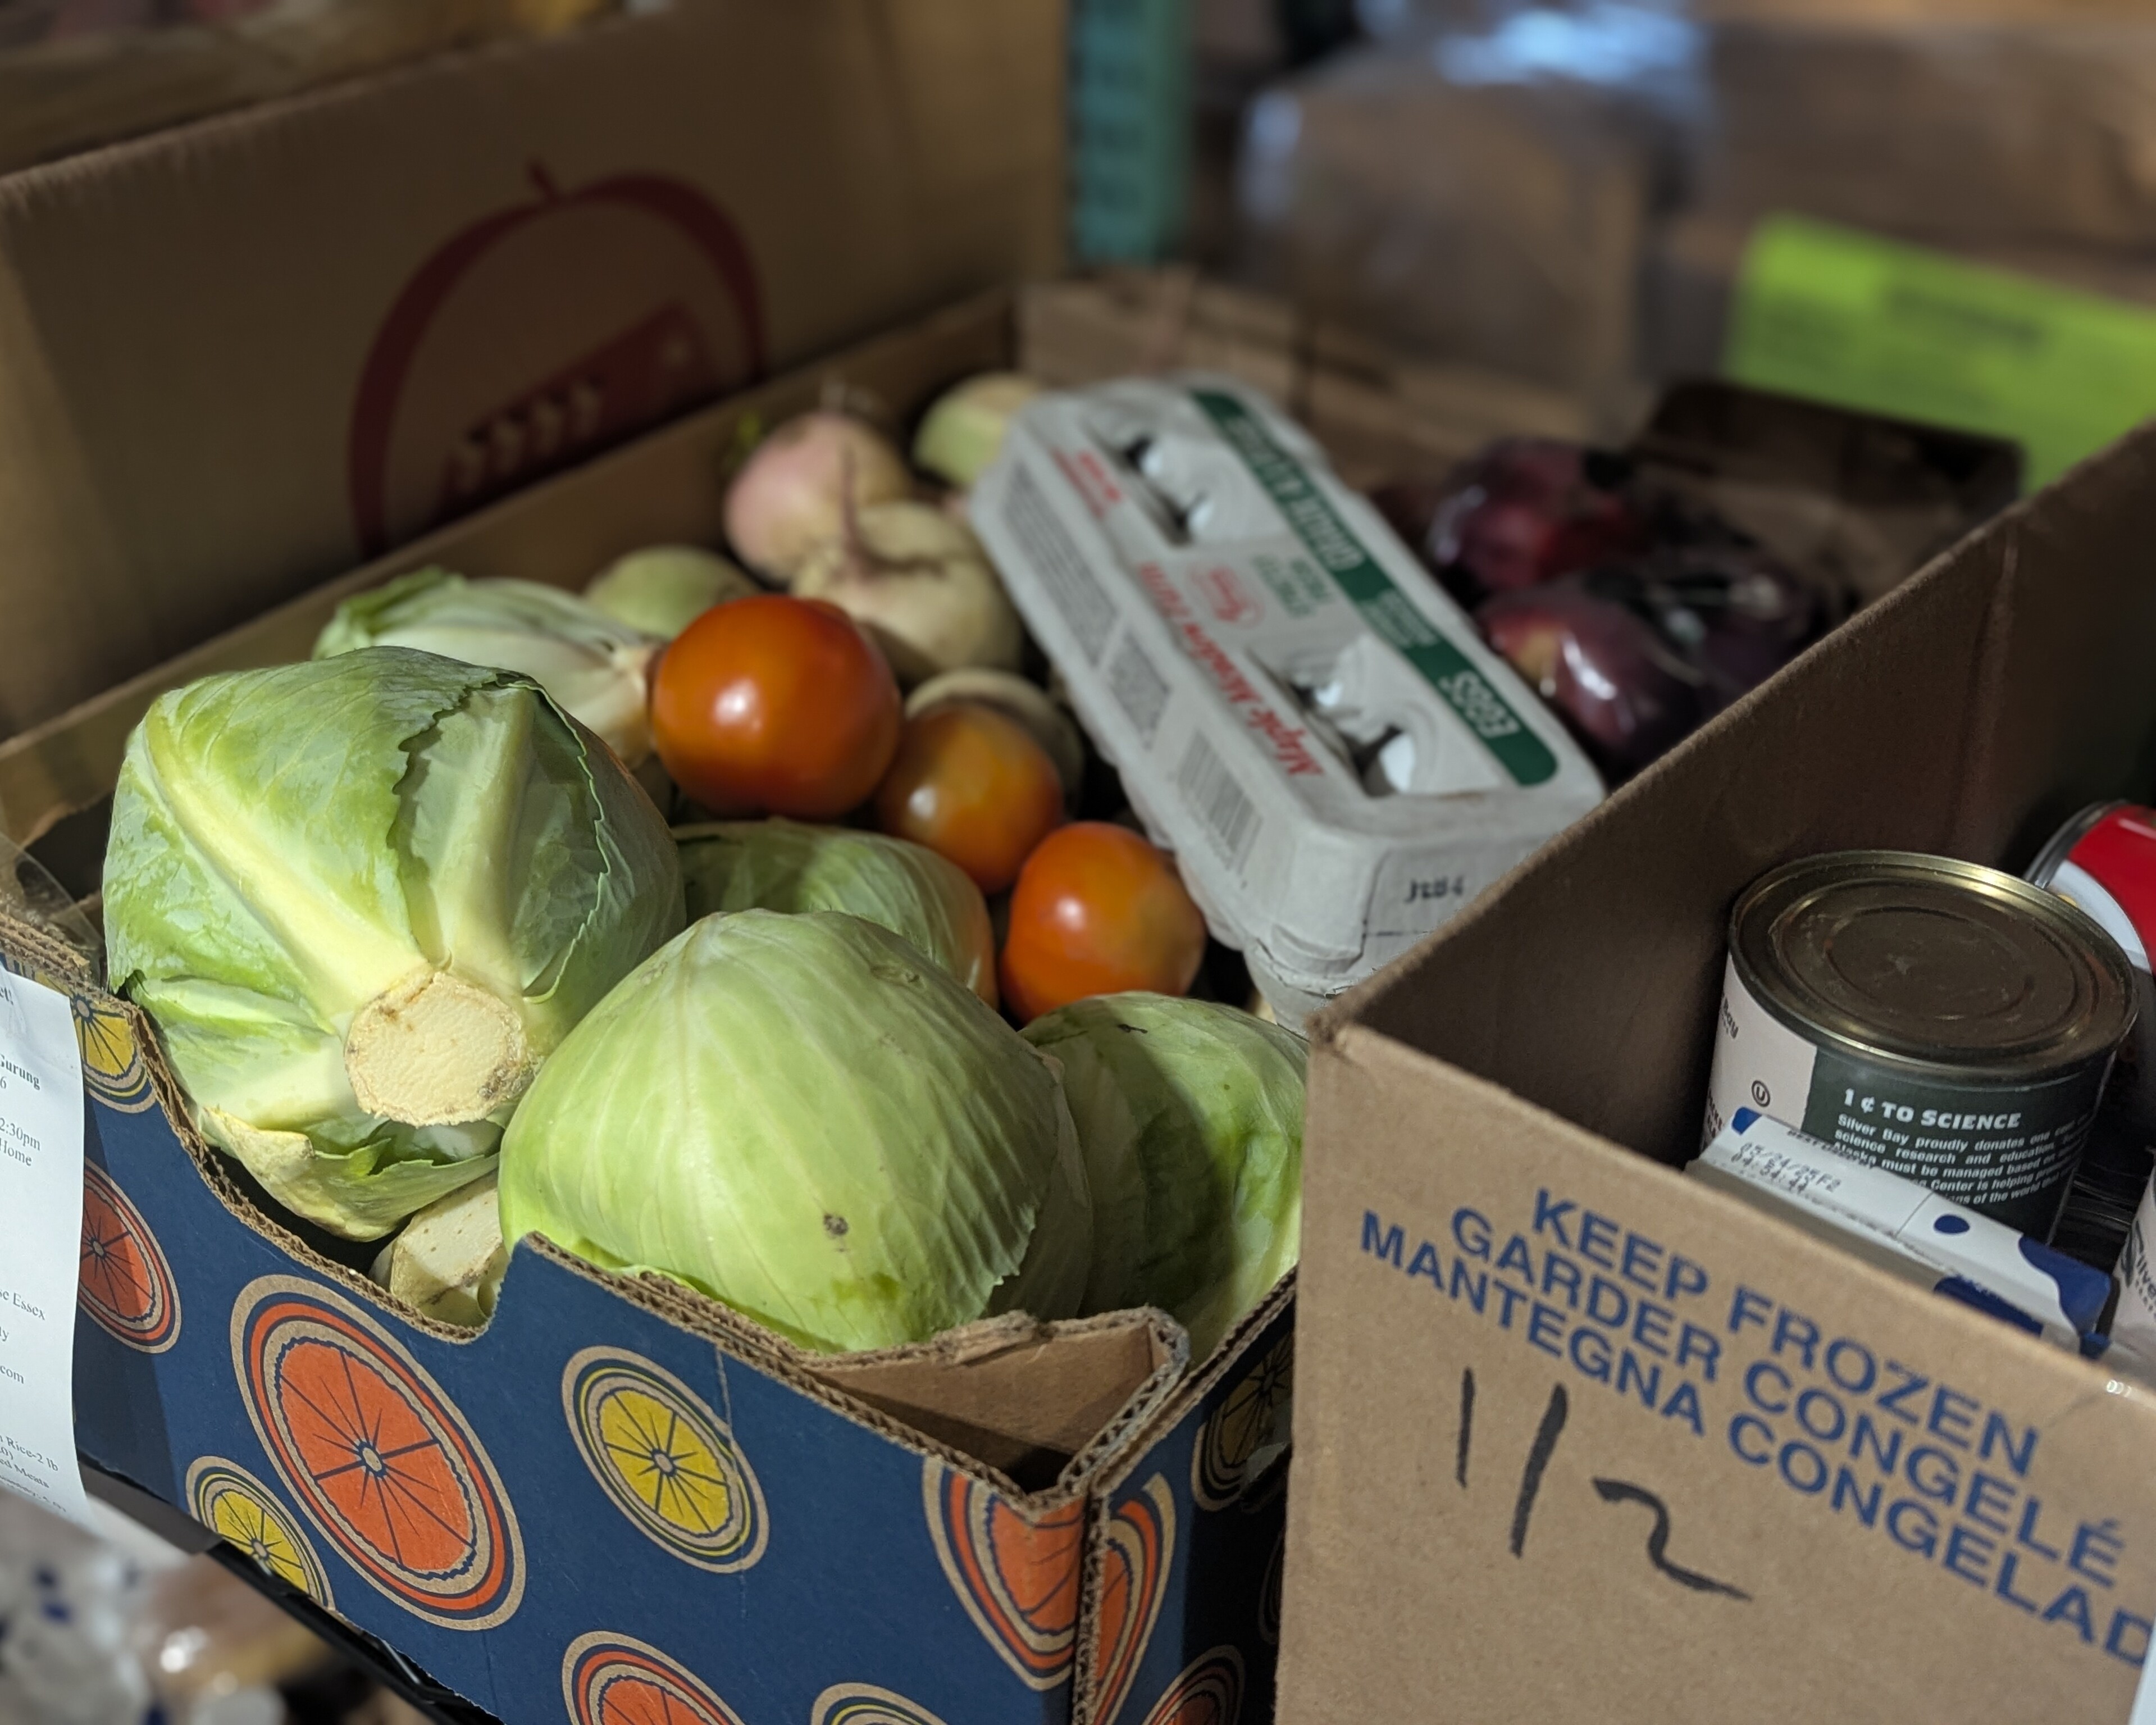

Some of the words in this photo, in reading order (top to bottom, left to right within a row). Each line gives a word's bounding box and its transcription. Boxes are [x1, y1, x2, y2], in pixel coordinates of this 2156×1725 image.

[1882, 1102, 1915, 1122] TO
[1921, 1110, 2022, 1130] SCIENCE
[1834, 1129, 1886, 1154] science
[1895, 1146, 1956, 1164] research
[1965, 1152, 1990, 1164] and
[1838, 1113, 1877, 1136] Silver
[1882, 1128, 1909, 1145] Bay
[1916, 1136, 1968, 1153] proudly
[1975, 1136, 2025, 1151] donates
[0, 1137, 32, 1167] Home
[1881, 1158, 1916, 1175] must
[1921, 1163, 1938, 1177] be
[1942, 1165, 2003, 1181] managed
[2007, 1156, 2040, 1175] based
[1931, 1180, 1975, 1193] Center
[1977, 1178, 1989, 1191] is
[1991, 1173, 2033, 1192] helping
[1973, 1193, 1986, 1205] of
[1989, 1191, 2008, 1203] the
[13, 1292, 45, 1321] Essex
[1534, 1190, 1707, 1299] KEEP
[1729, 1289, 2038, 1477] FROZEN
[1452, 1209, 1720, 1380] GARDER
[1745, 1362, 2126, 1589] CONGELÉ
[6, 1436, 44, 1464] Rice-2
[1362, 1213, 1703, 1434] MANTEGNA
[1729, 1414, 2153, 1670] CONGELAD
[14, 1464, 49, 1489] Meats
